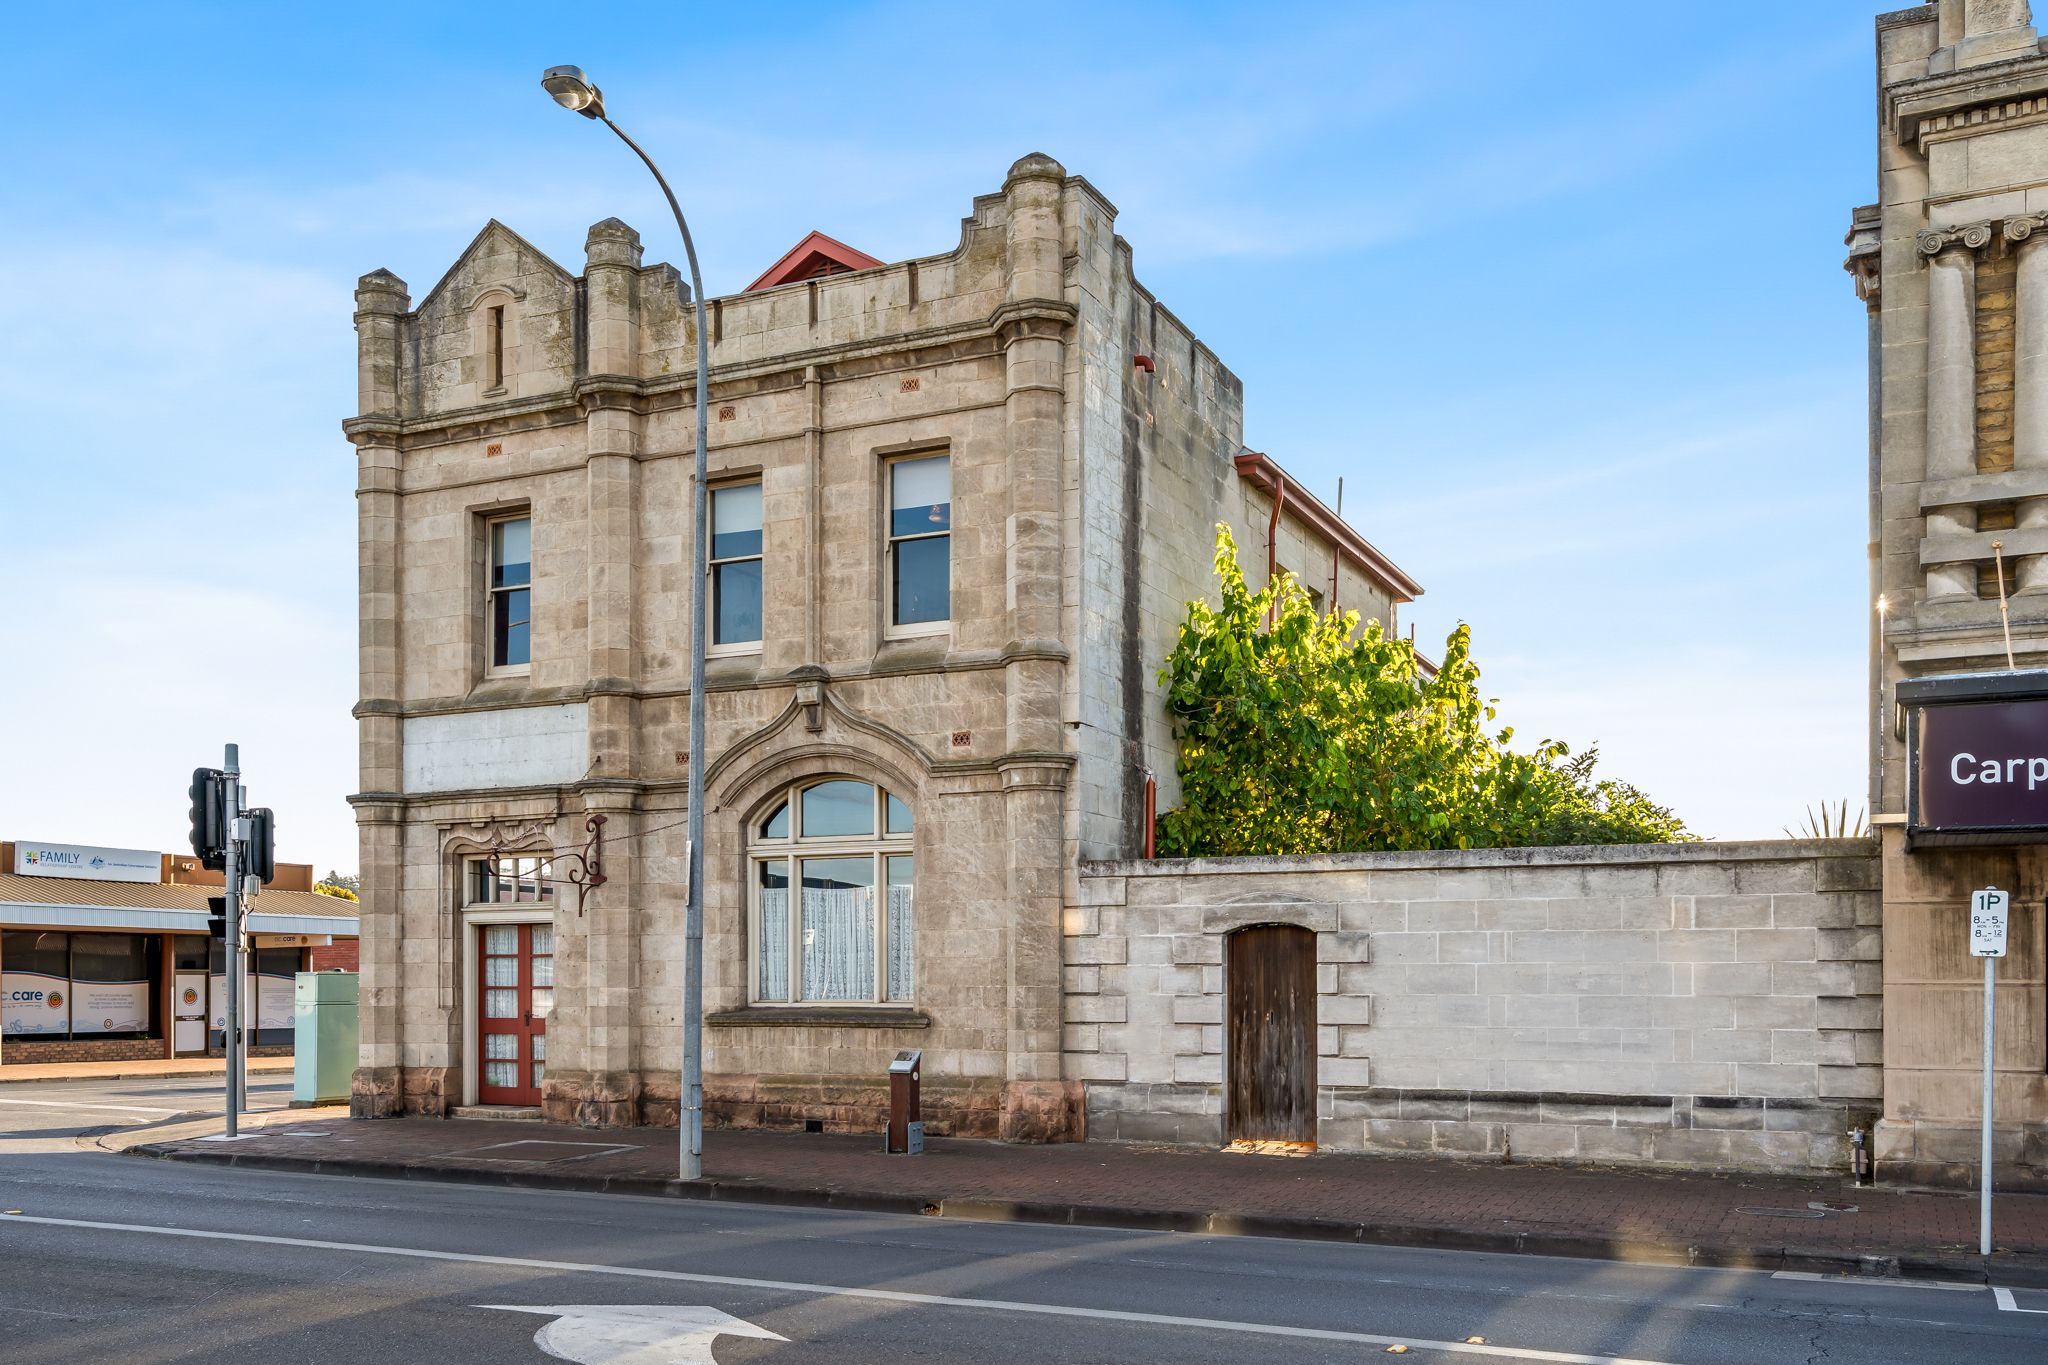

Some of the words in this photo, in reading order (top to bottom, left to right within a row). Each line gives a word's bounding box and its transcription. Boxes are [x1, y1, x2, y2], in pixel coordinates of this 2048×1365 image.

[1951, 752, 2048, 790] Carp
[40, 850, 80, 864] FAMILY
[1979, 894, 2001, 910] 1P
